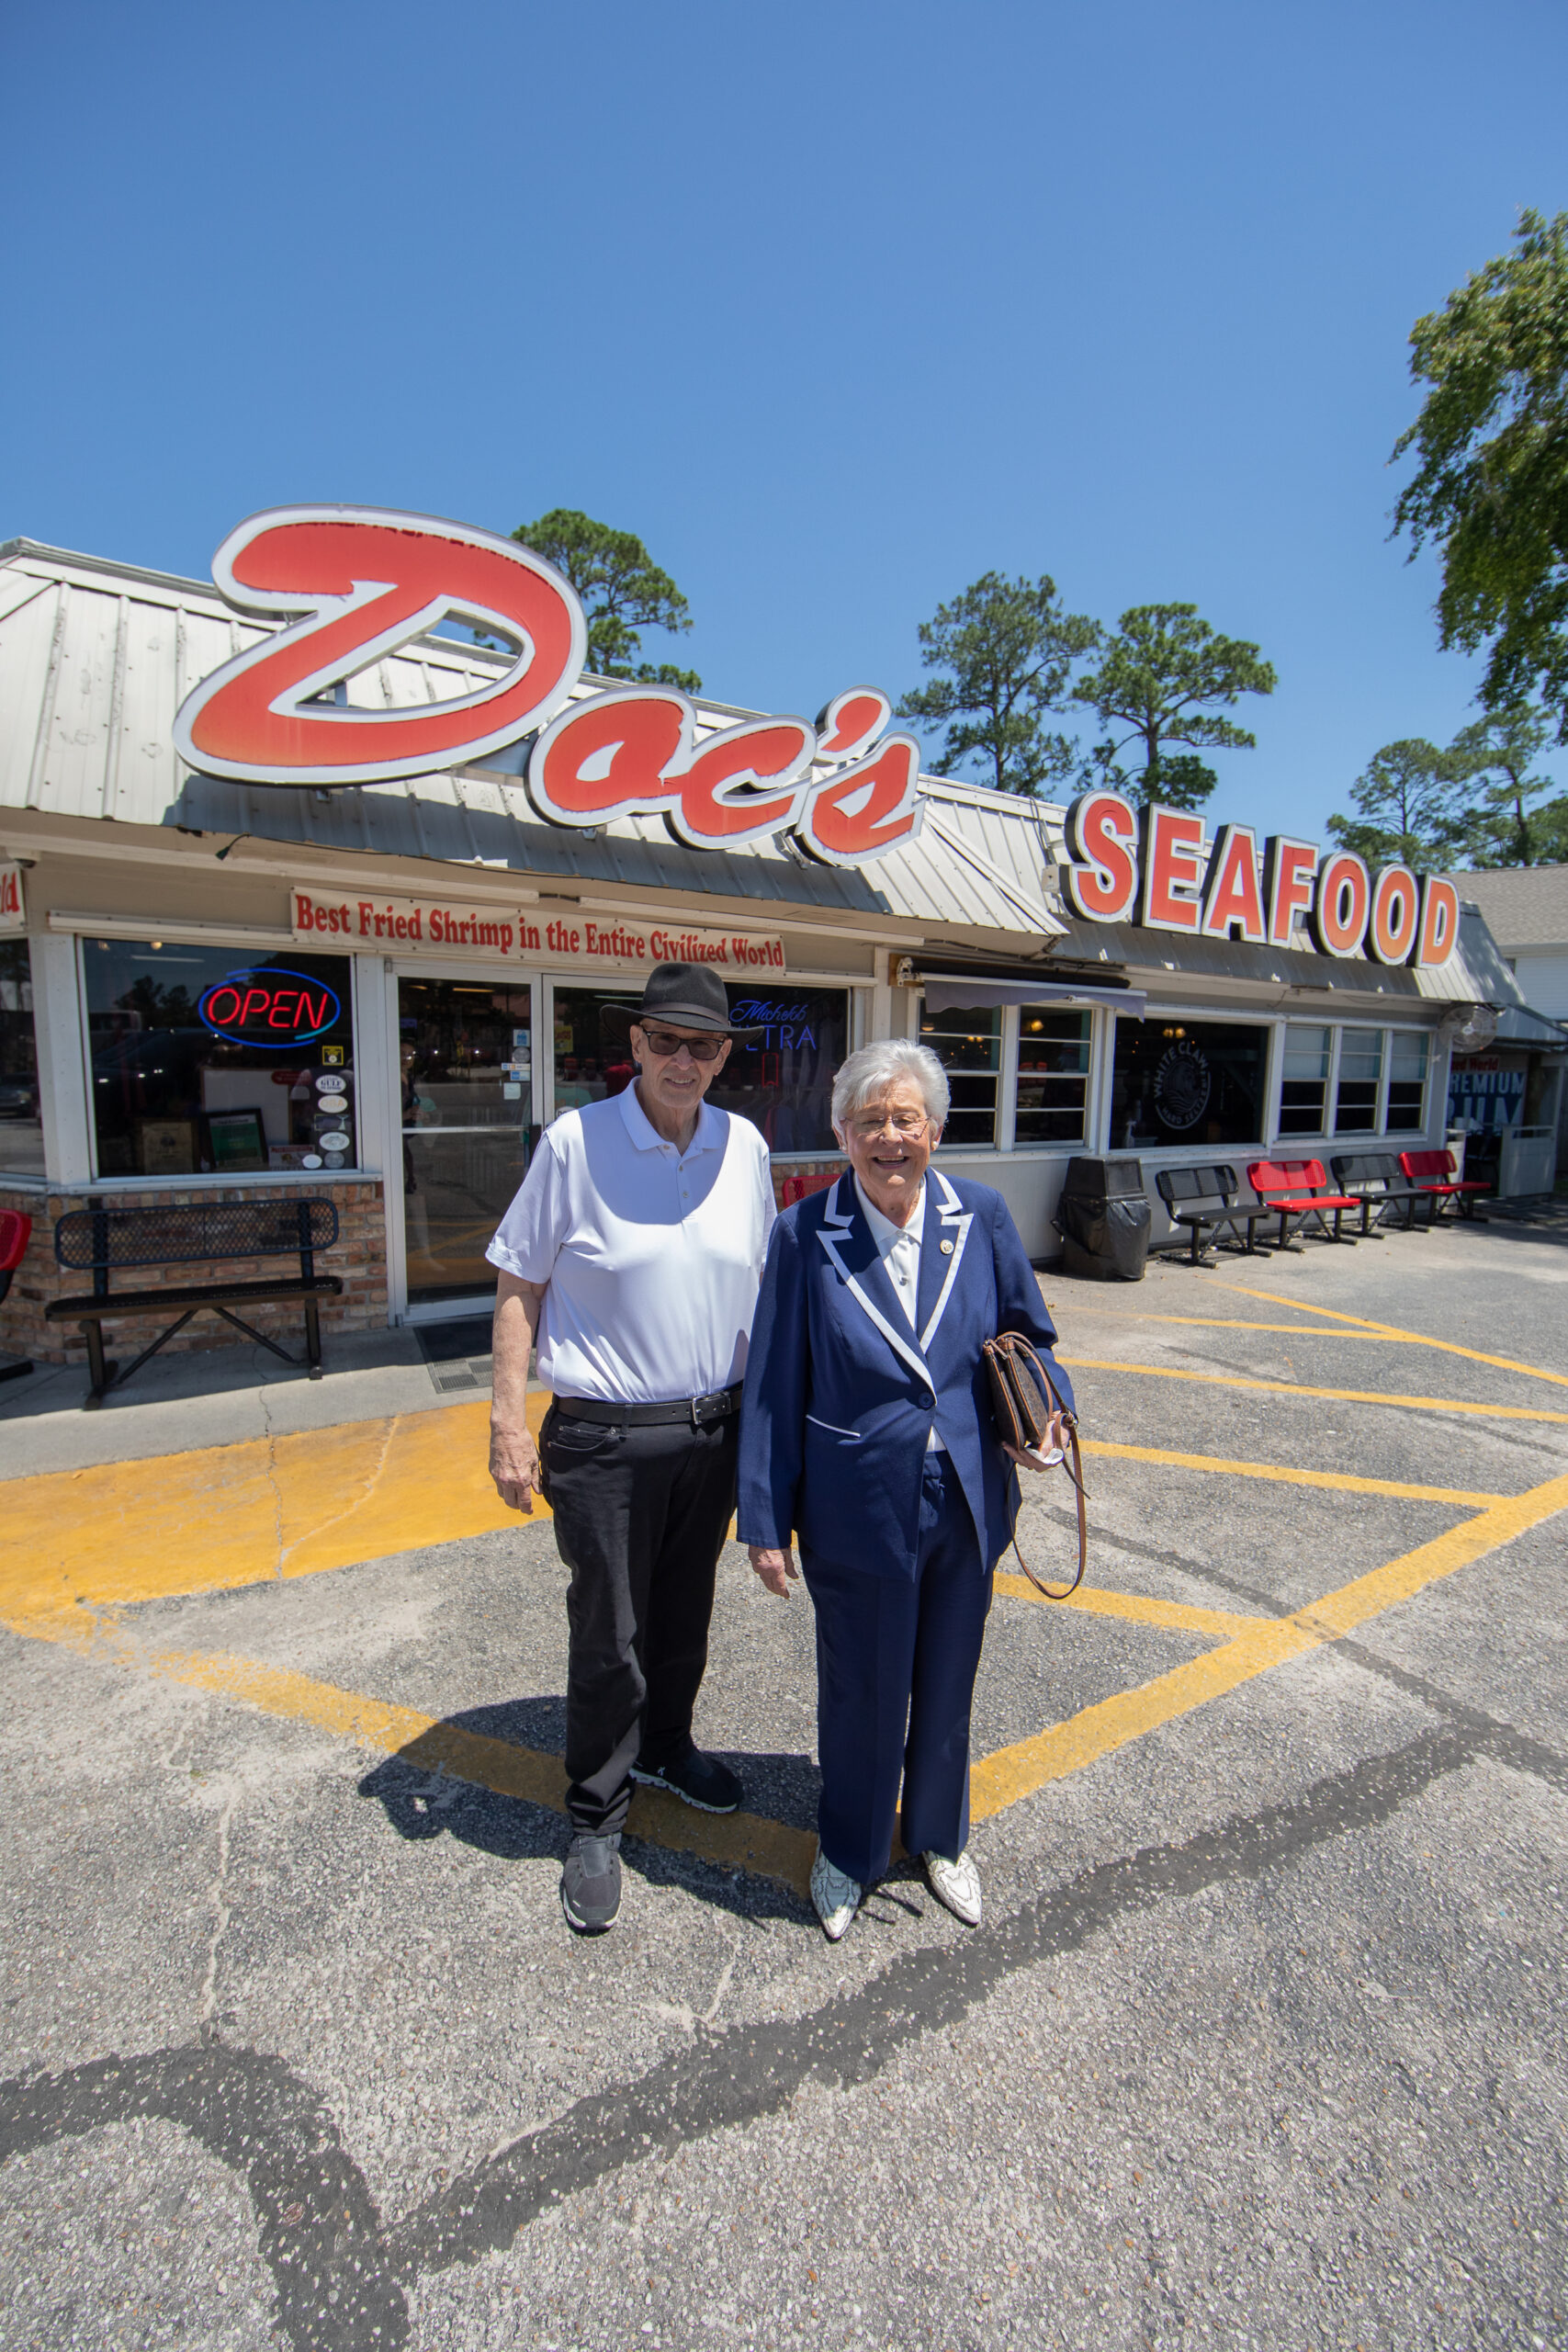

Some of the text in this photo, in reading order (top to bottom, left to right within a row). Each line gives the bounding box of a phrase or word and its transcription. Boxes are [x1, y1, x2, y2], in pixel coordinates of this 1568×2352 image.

[173, 503, 921, 866] Doc's
[1061, 788, 1460, 970] SEAFOOD
[295, 894, 784, 967] Best Fried Shrimp in the Entire Civilized World
[208, 988, 328, 1029] OPEN
[729, 1000, 808, 1023] Michelob
[1449, 1071, 1527, 1094] REMIUM
